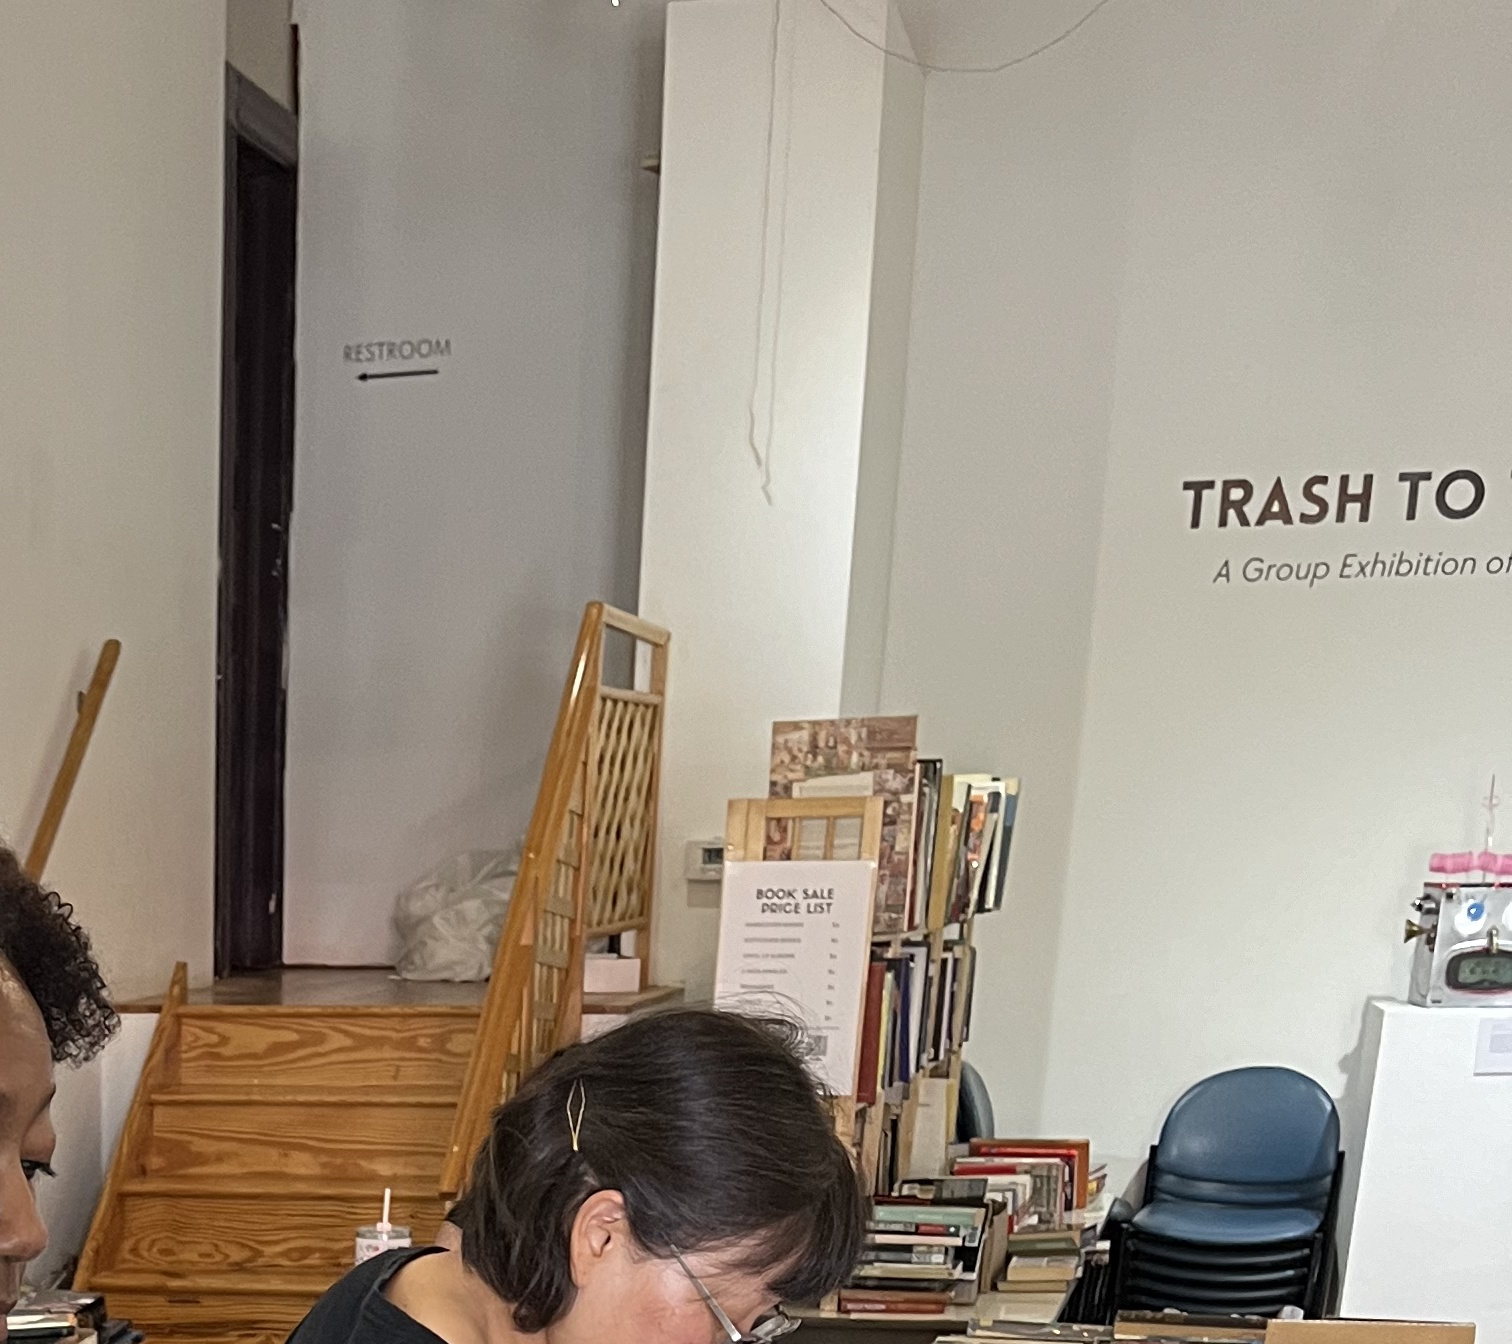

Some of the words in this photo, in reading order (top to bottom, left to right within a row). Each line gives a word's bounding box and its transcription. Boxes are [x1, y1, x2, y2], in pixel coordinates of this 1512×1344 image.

[343, 338, 452, 364] RESTROOM
[1182, 473, 1374, 530] TRASH
[1397, 469, 1486, 522] TO
[1212, 559, 1231, 585] A
[1242, 556, 1331, 588] Group
[1338, 551, 1478, 580] Exhibition
[756, 888, 798, 901] BOOK
[802, 888, 835, 901] SALE
[761, 902, 801, 915] PRICE
[806, 902, 834, 915] LIST
